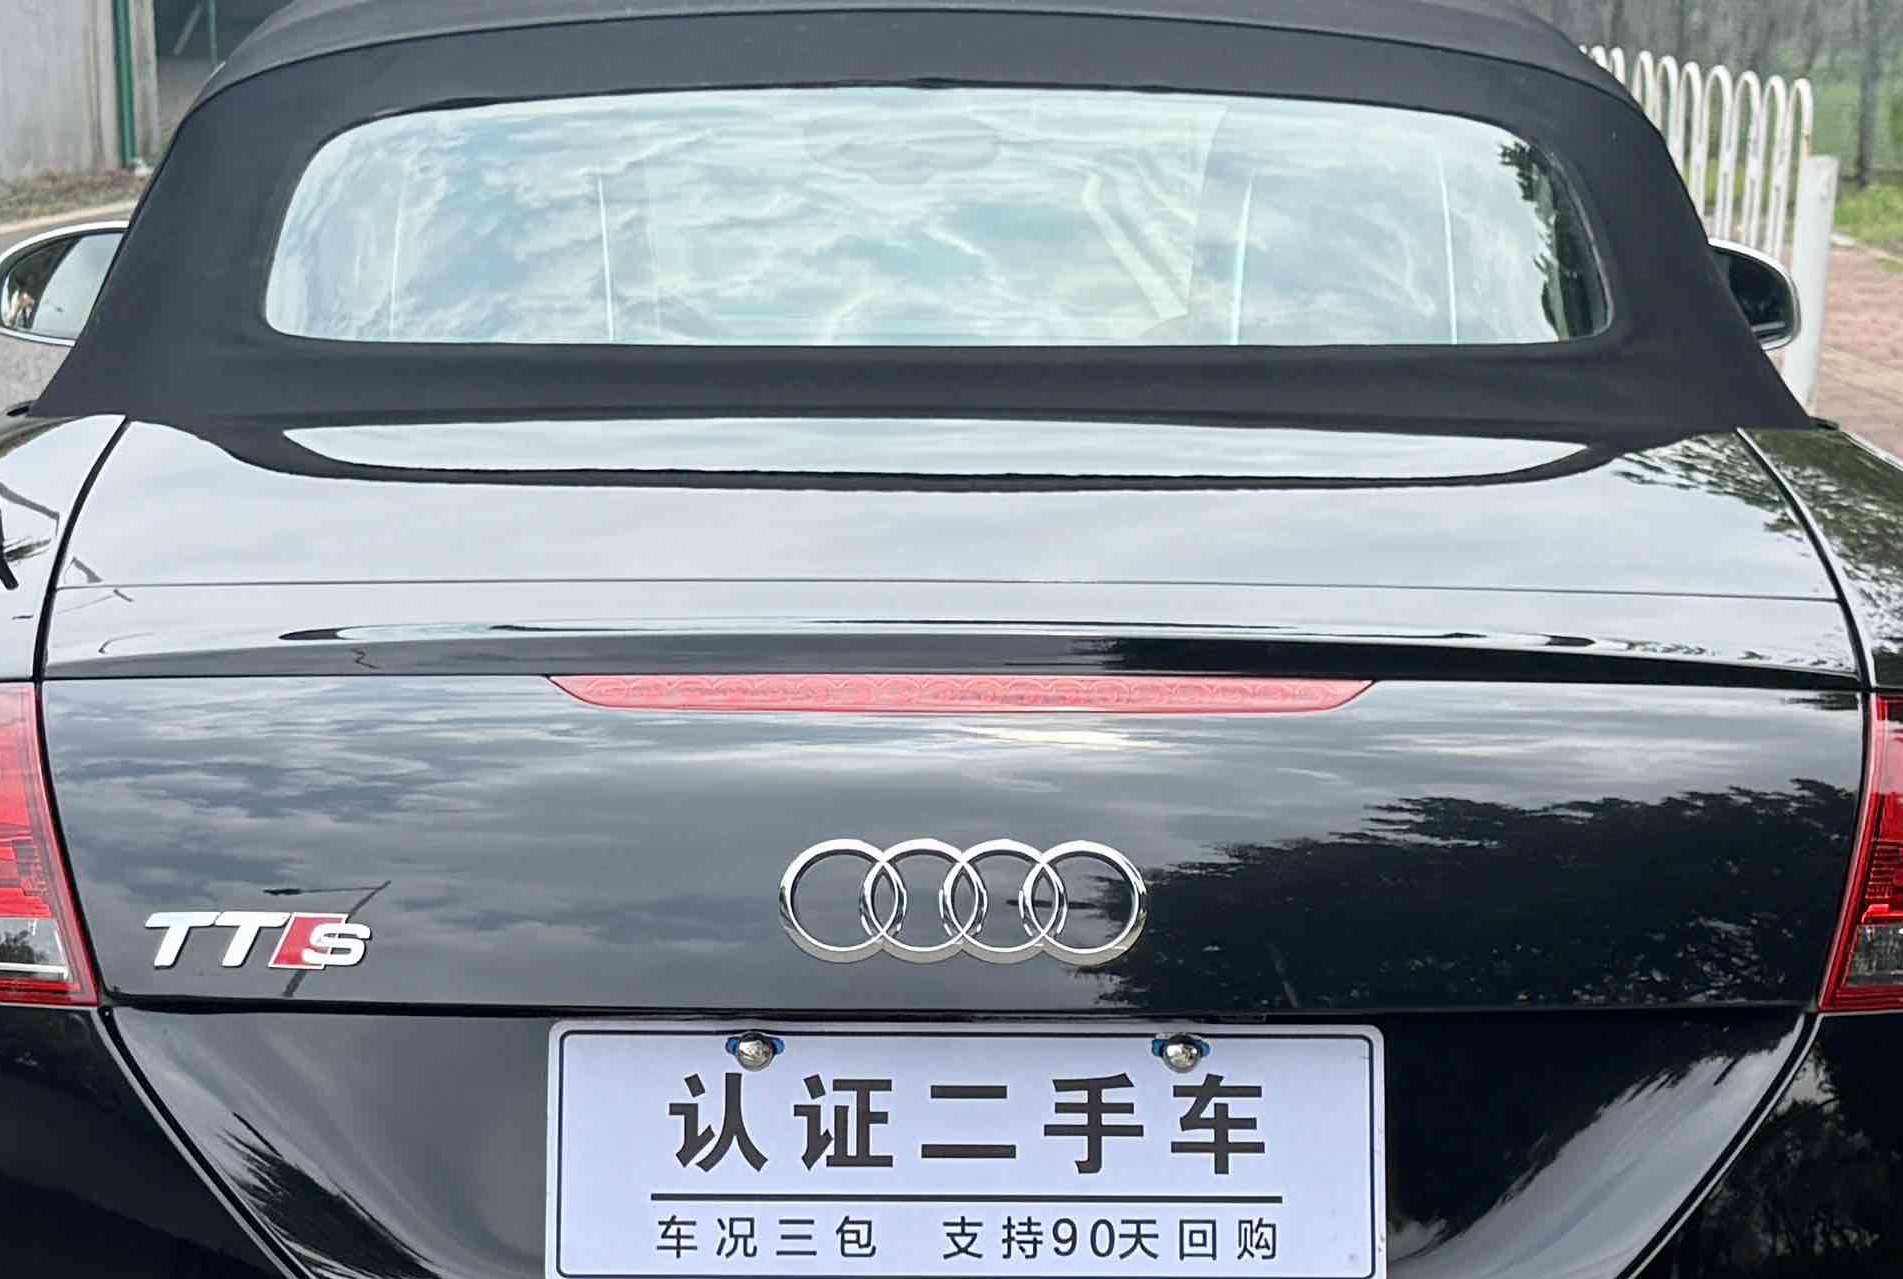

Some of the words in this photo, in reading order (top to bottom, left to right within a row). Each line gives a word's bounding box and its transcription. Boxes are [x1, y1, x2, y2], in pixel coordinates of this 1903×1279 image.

[145, 911, 372, 970] TTS
[668, 1072, 1266, 1176] 认证二手车
[656, 1214, 878, 1261] 车况三包
[941, 1214, 1279, 1261] 支持90天回购
